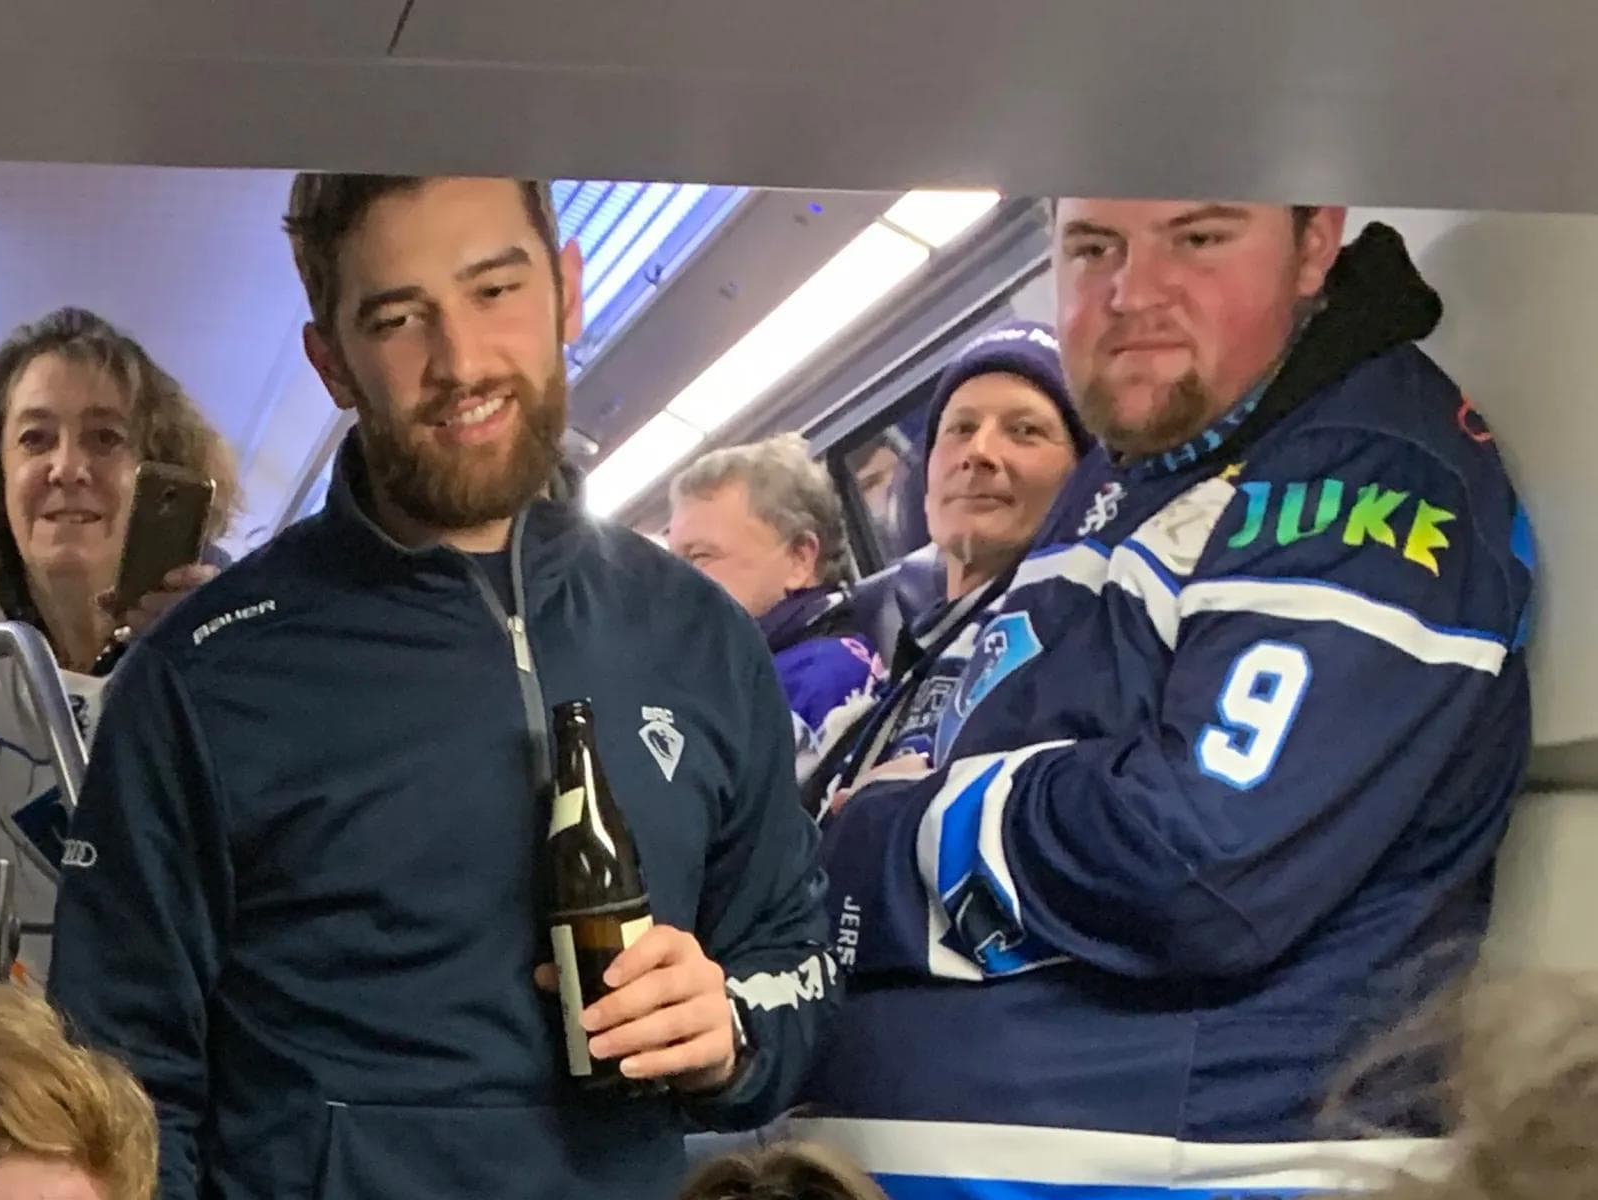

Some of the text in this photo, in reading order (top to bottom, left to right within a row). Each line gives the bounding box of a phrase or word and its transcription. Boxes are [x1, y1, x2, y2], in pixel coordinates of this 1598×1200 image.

[1227, 478, 1457, 578] JUKE
[1196, 641, 1312, 790] 9
[836, 895, 862, 967] JERS
